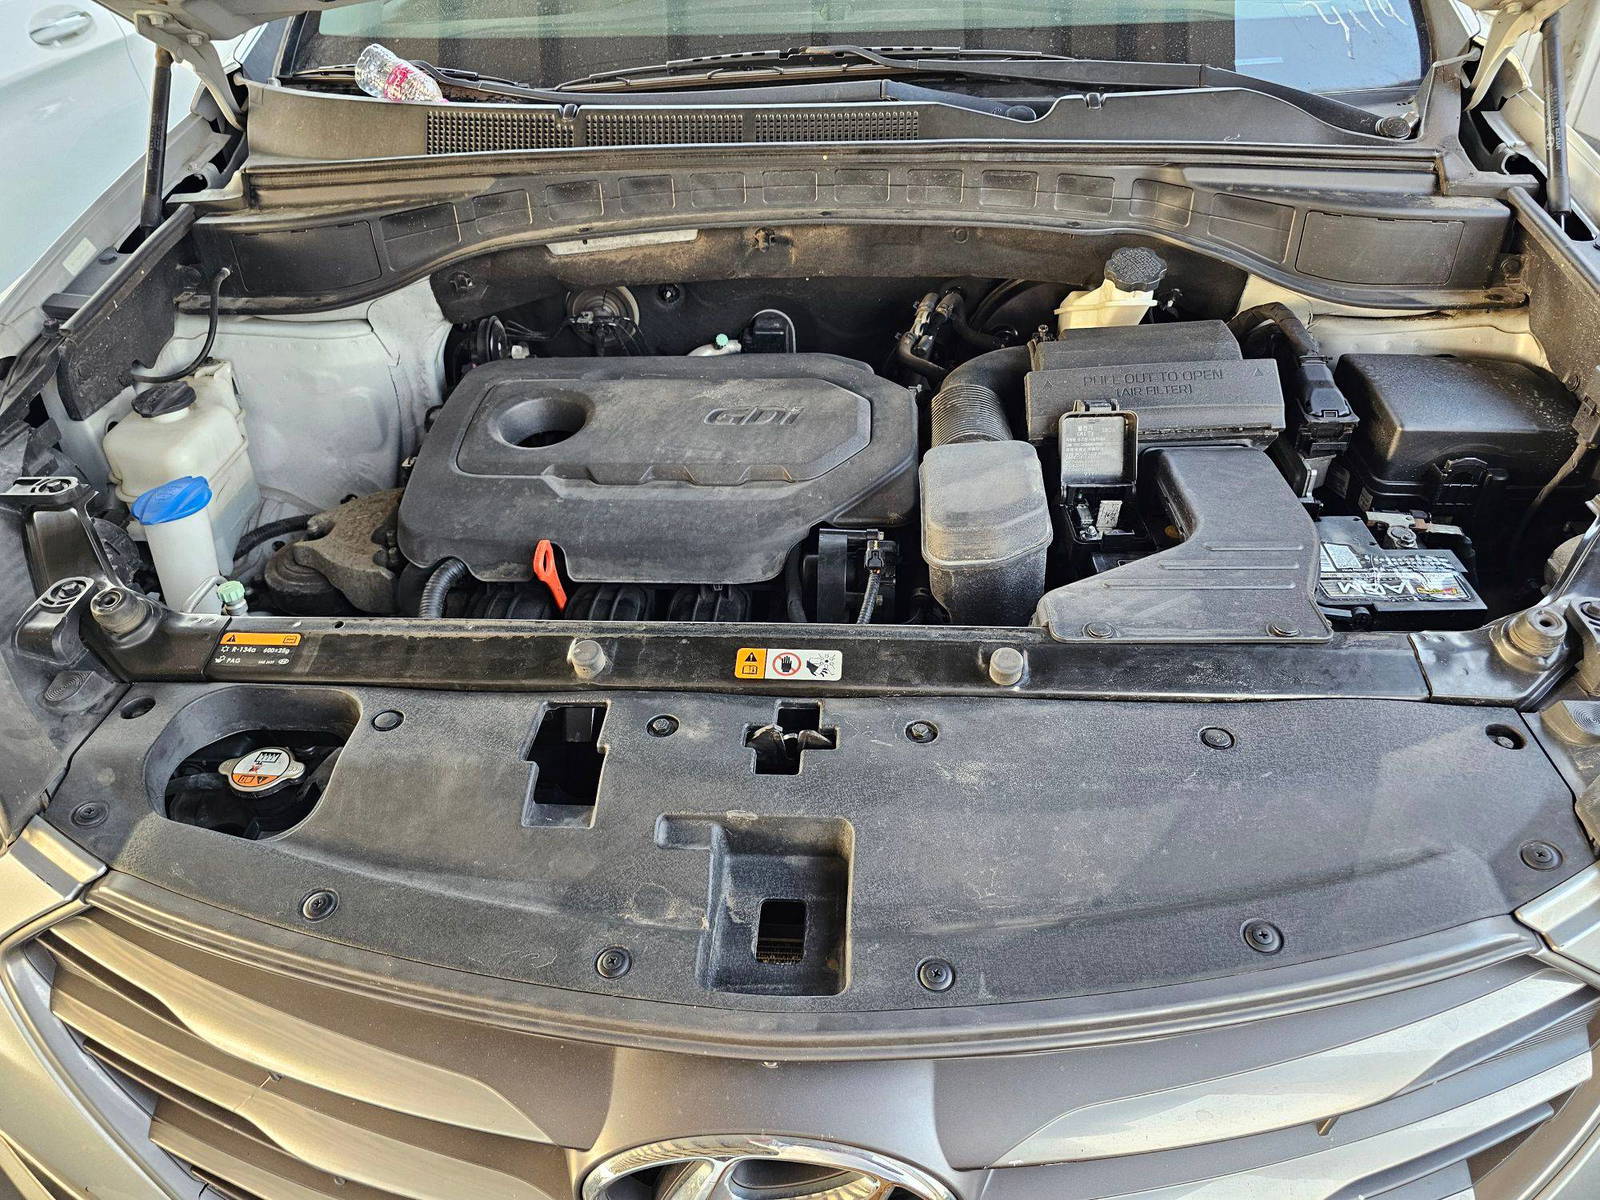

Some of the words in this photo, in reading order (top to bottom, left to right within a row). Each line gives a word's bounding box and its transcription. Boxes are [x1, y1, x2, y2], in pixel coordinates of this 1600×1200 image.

[1124, 373, 1154, 384] OUT
[1159, 371, 1178, 382] TO
[1182, 369, 1224, 382] OPEN
[231, 646, 257, 654] R-134a
